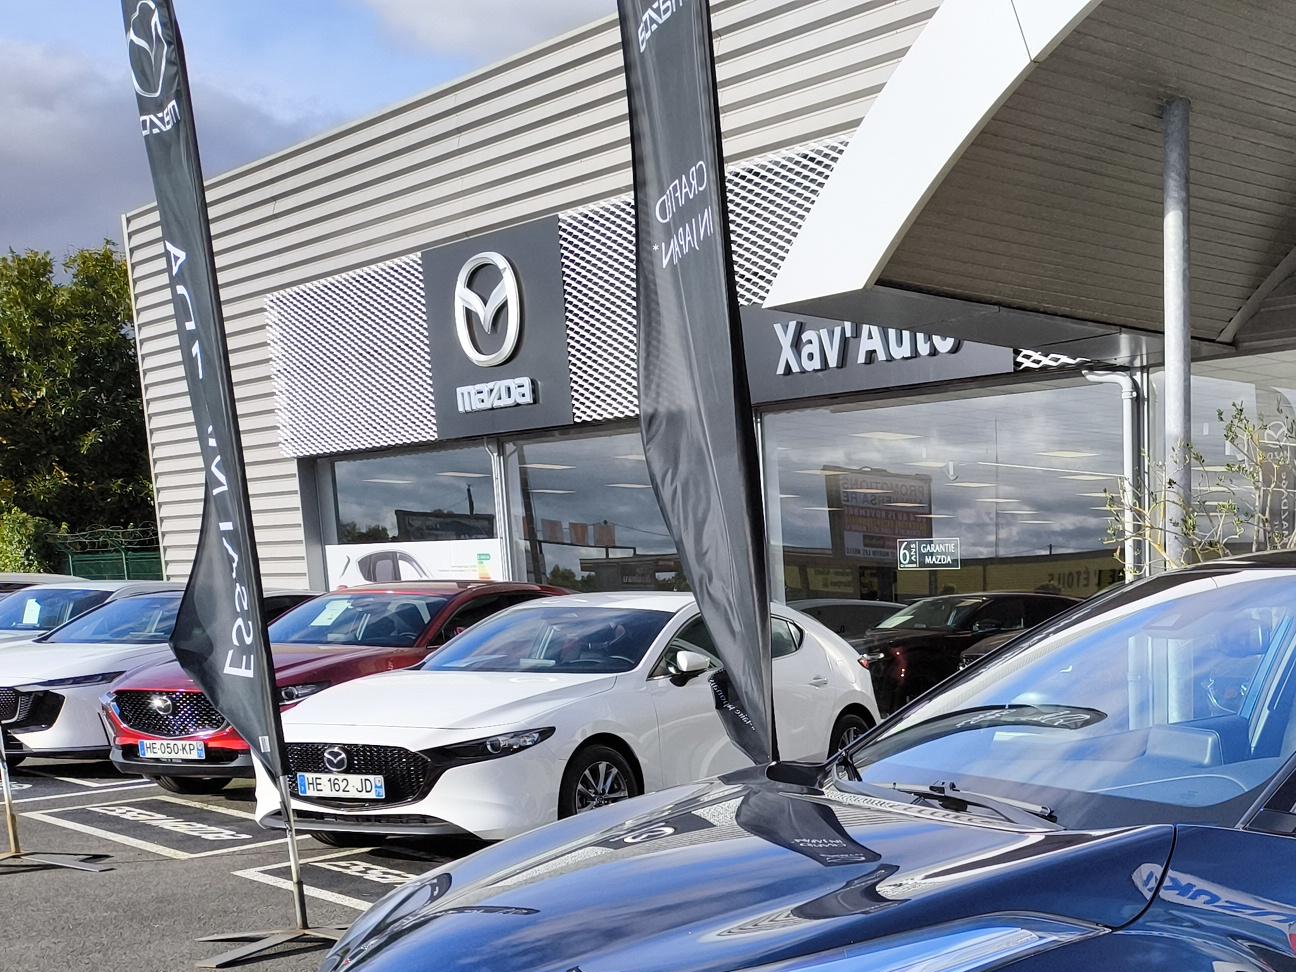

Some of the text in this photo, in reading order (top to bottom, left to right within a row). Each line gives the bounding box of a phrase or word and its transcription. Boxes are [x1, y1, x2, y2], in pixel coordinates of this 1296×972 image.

[900, 541, 910, 564] 6
[921, 543, 956, 554] GARANTIE
[925, 555, 952, 565] MAZDA
